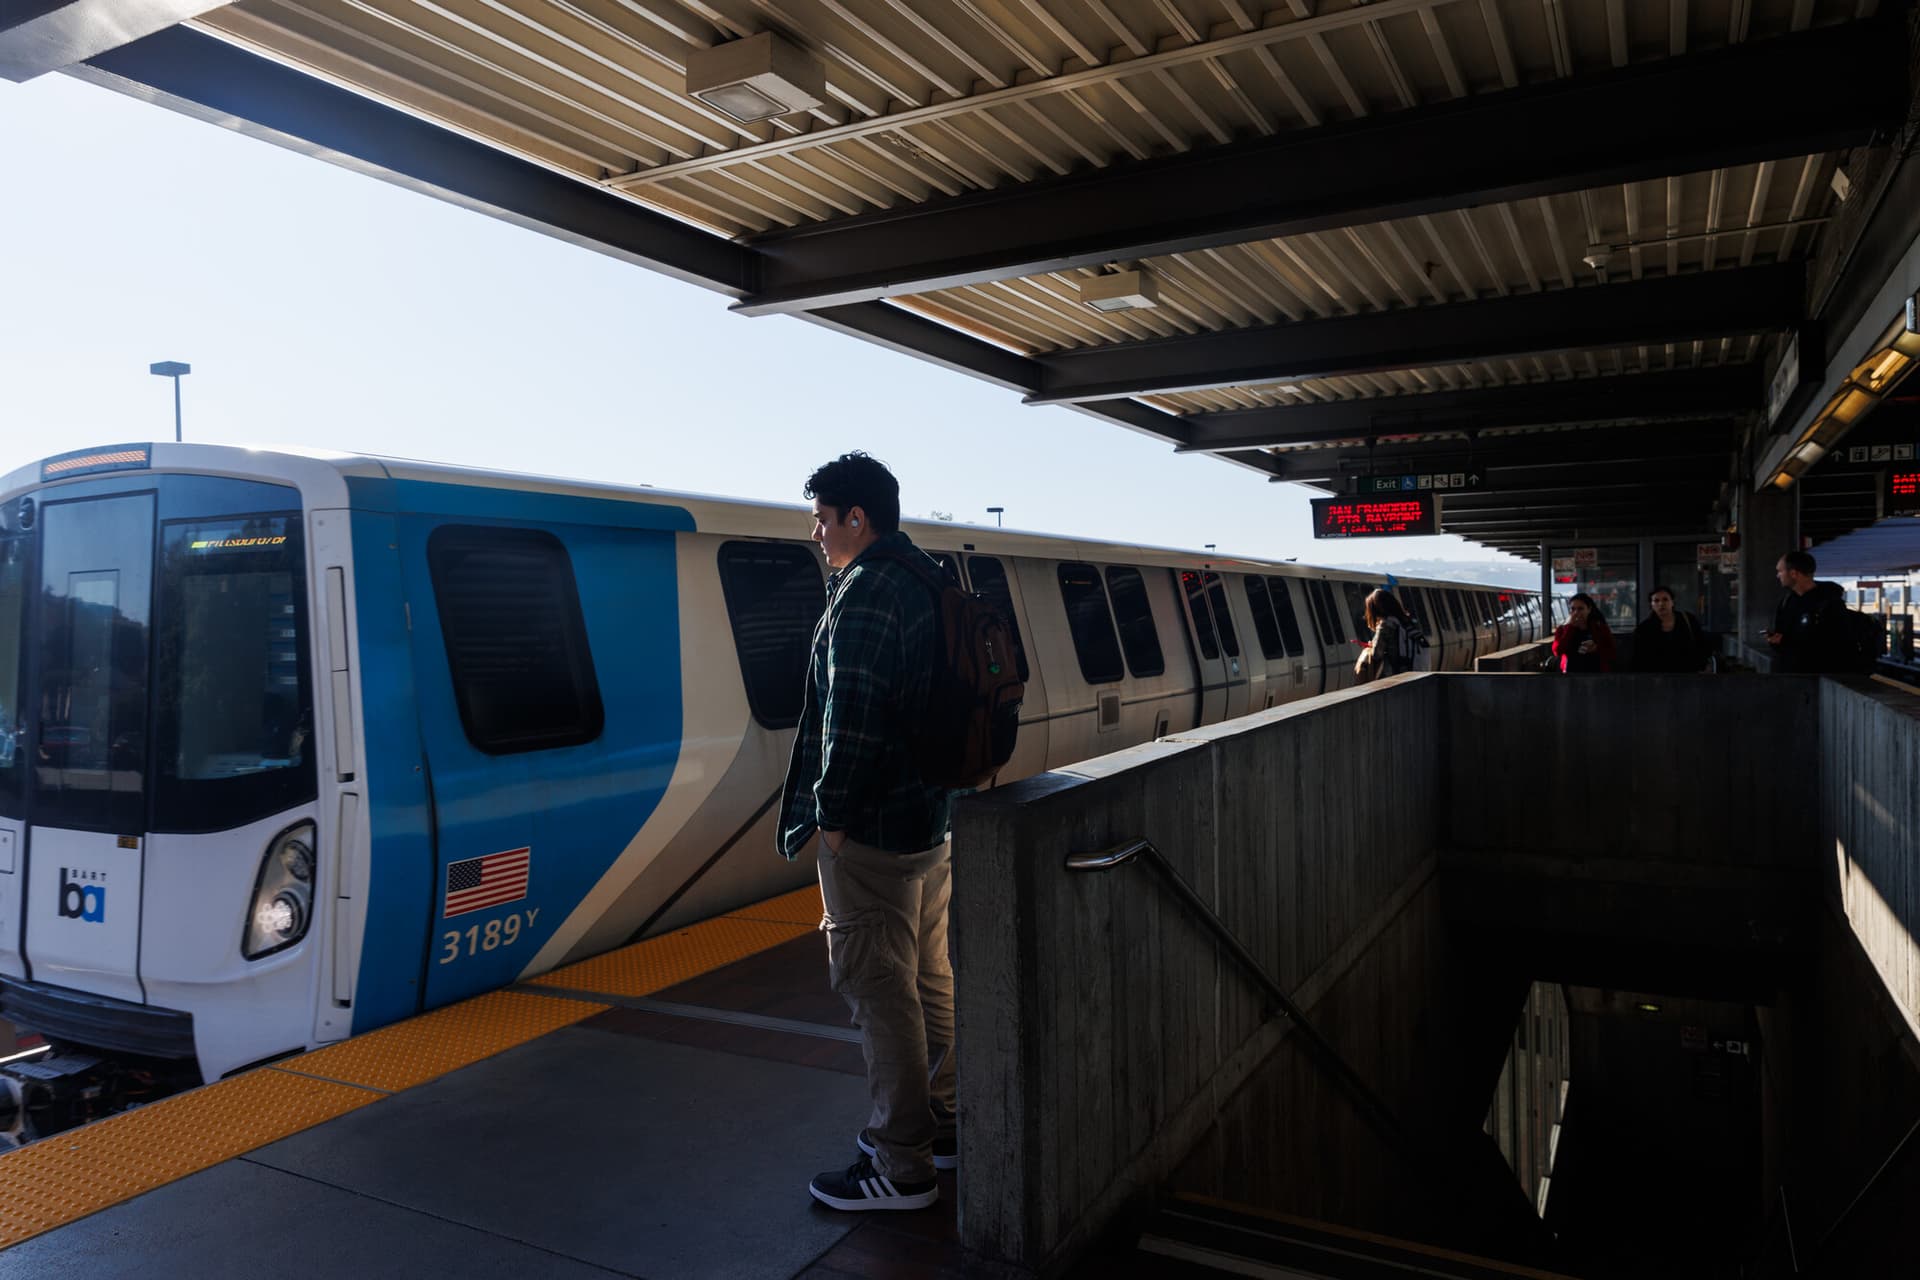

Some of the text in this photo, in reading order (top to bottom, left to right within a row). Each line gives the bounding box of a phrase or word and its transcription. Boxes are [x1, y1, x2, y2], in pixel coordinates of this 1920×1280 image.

[1376, 480, 1396, 489] Exit
[1329, 505, 1352, 515] SAN
[71, 869, 107, 881] BART
[58, 867, 105, 923] ba
